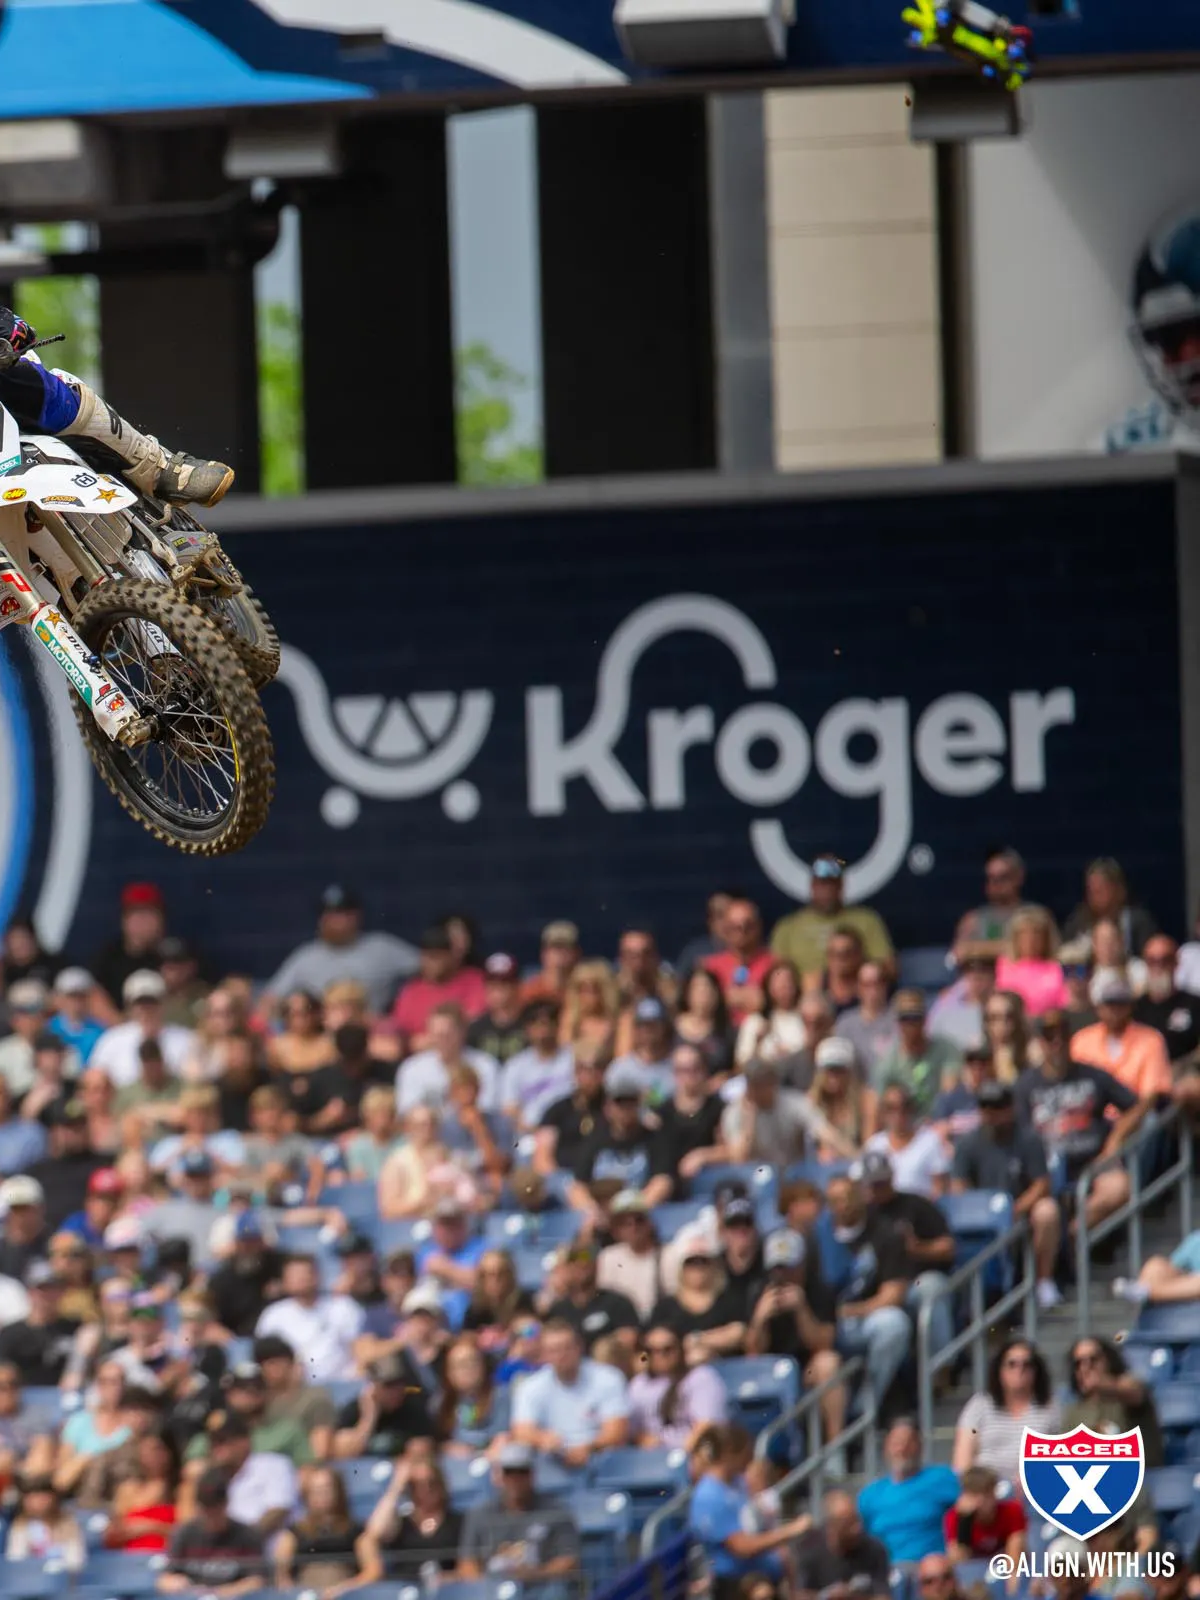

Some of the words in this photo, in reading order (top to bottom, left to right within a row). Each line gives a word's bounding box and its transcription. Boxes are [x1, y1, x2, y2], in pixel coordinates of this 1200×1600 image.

[47, 639, 89, 694] MOTOREX
[67, 635, 108, 682] DUNOP
[525, 592, 1075, 905] Kroger
